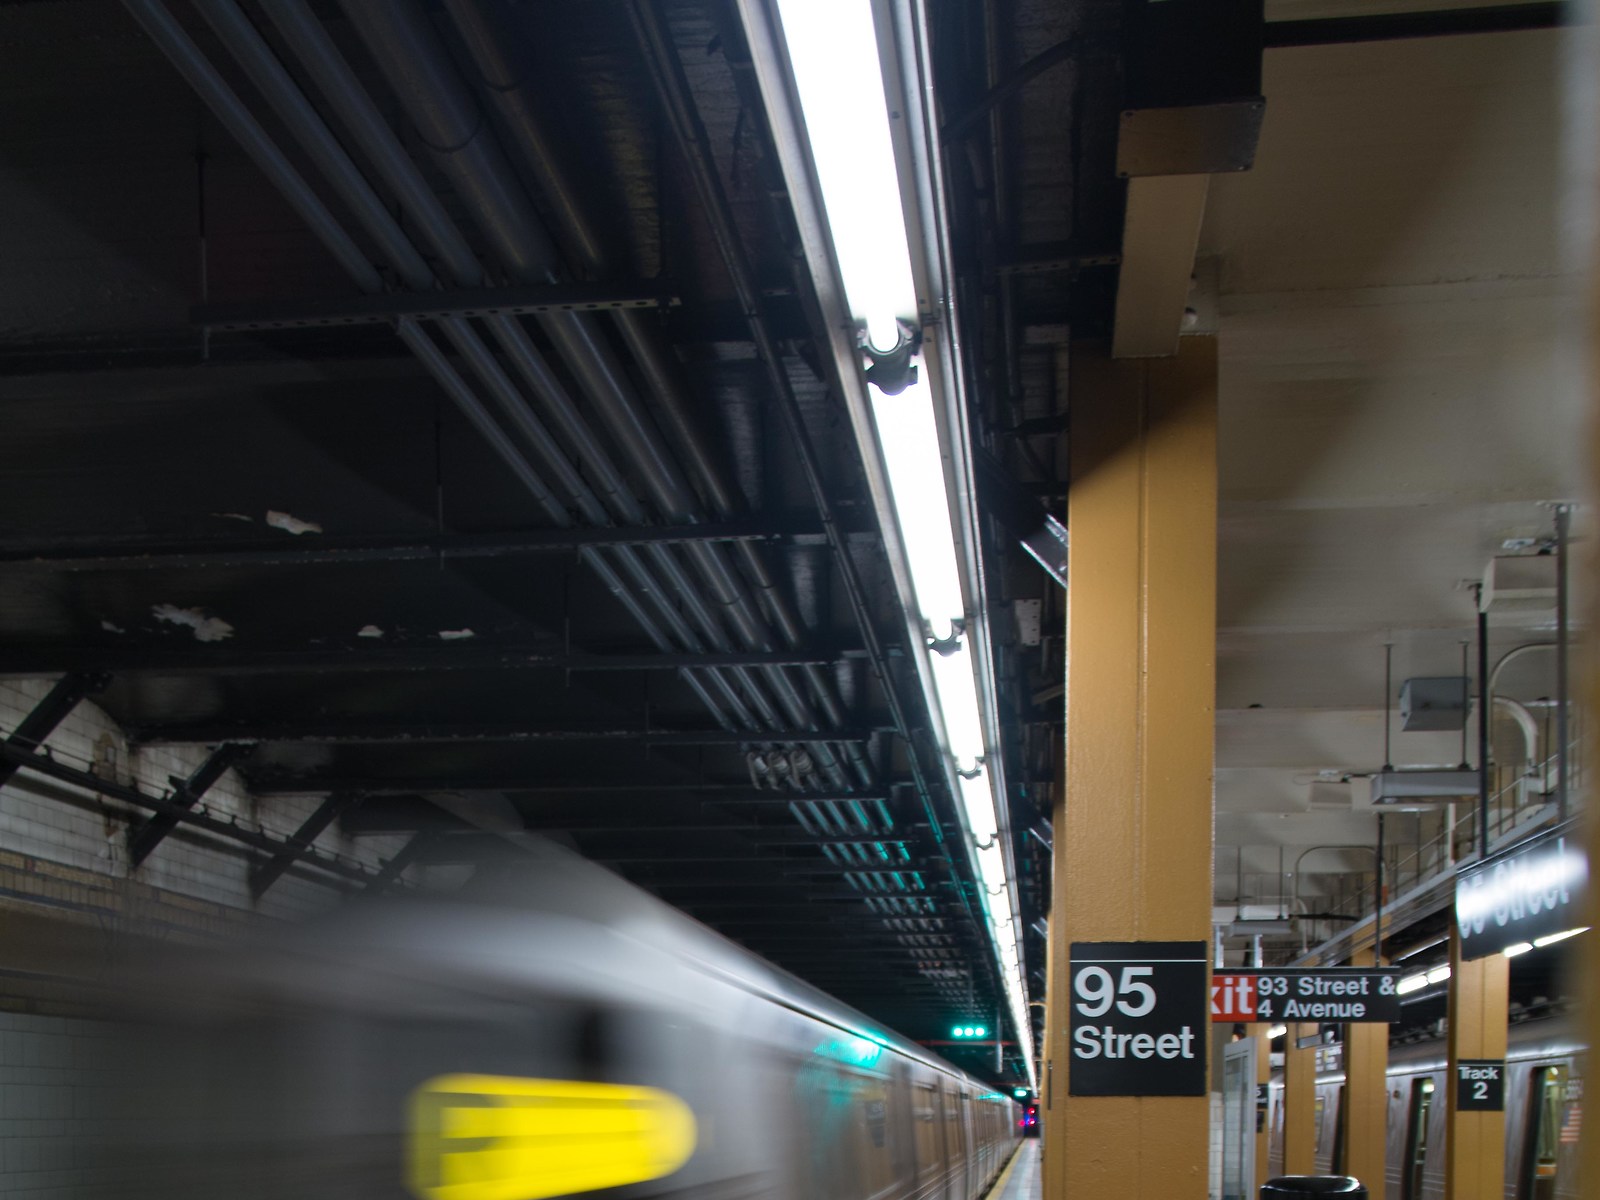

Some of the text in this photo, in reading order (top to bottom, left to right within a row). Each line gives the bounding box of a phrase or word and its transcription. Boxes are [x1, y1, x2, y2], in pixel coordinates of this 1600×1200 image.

[1074, 965, 1157, 1018] 95
[1257, 976, 1396, 996] 93 Street &
[1257, 999, 1366, 1018] 4 Avenue
[1074, 1024, 1195, 1059] Street
[1458, 1066, 1499, 1080] Track
[1473, 1081, 1489, 1100] 2
